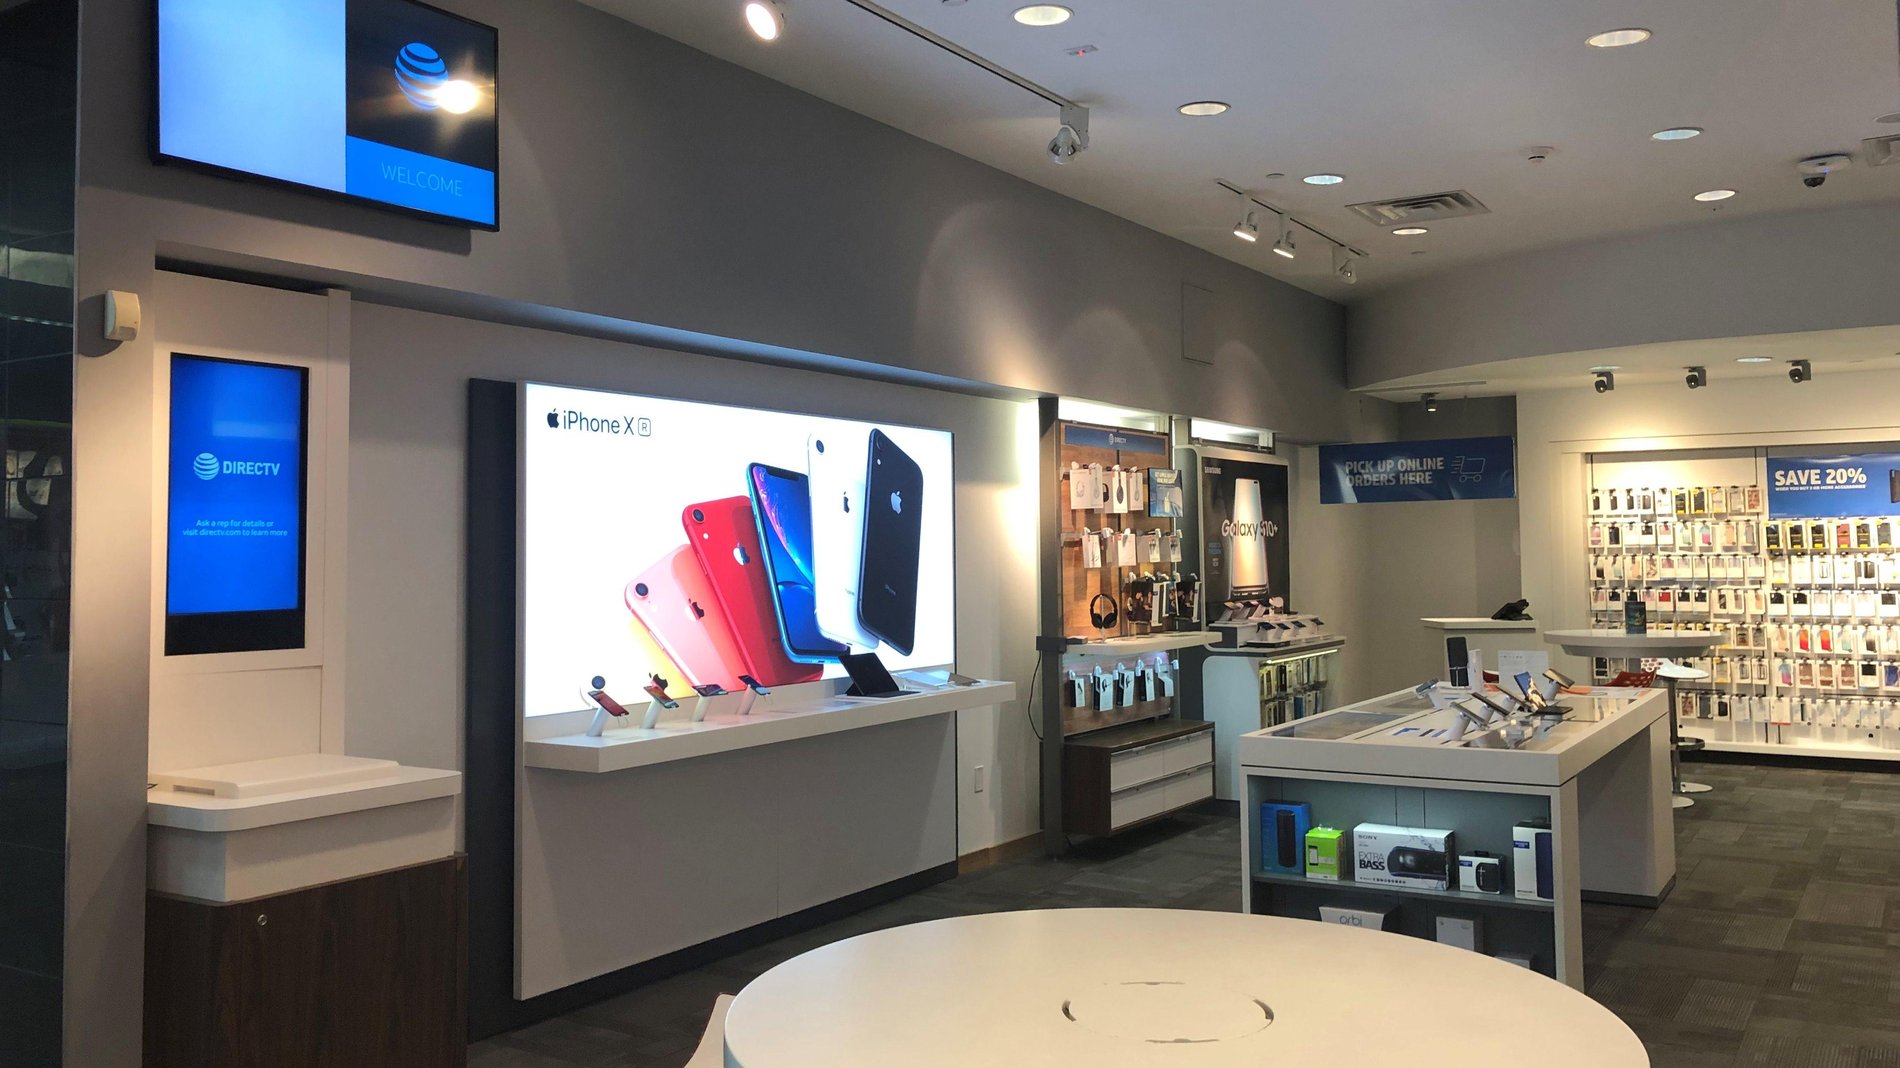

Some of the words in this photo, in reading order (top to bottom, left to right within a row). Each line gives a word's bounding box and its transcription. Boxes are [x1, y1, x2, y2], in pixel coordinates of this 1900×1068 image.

[381, 161, 463, 197] WELCOME
[563, 410, 620, 434] iPhone
[223, 460, 280, 476] DIRECTV
[1345, 460, 1374, 474] PICK
[1377, 459, 1395, 472] UP
[1397, 457, 1444, 472] ONLINE
[1345, 473, 1396, 487] ORDERS
[1400, 472, 1433, 485] HERE
[1775, 469, 1821, 486] SAVE
[1825, 467, 1867, 484] 20%
[196, 519, 210, 528] Ask
[217, 521, 230, 529] rep
[230, 519, 242, 528] for
[242, 519, 266, 528] details
[1221, 519, 1258, 541] Galaxy
[1259, 520, 1278, 537] S10+
[182, 528, 199, 536] visit
[200, 528, 241, 536] directv.com
[250, 528, 269, 536] learn
[1359, 851, 1385, 861] EXTRA
[1359, 859, 1385, 871] BASS
[1339, 914, 1362, 927] orbi
